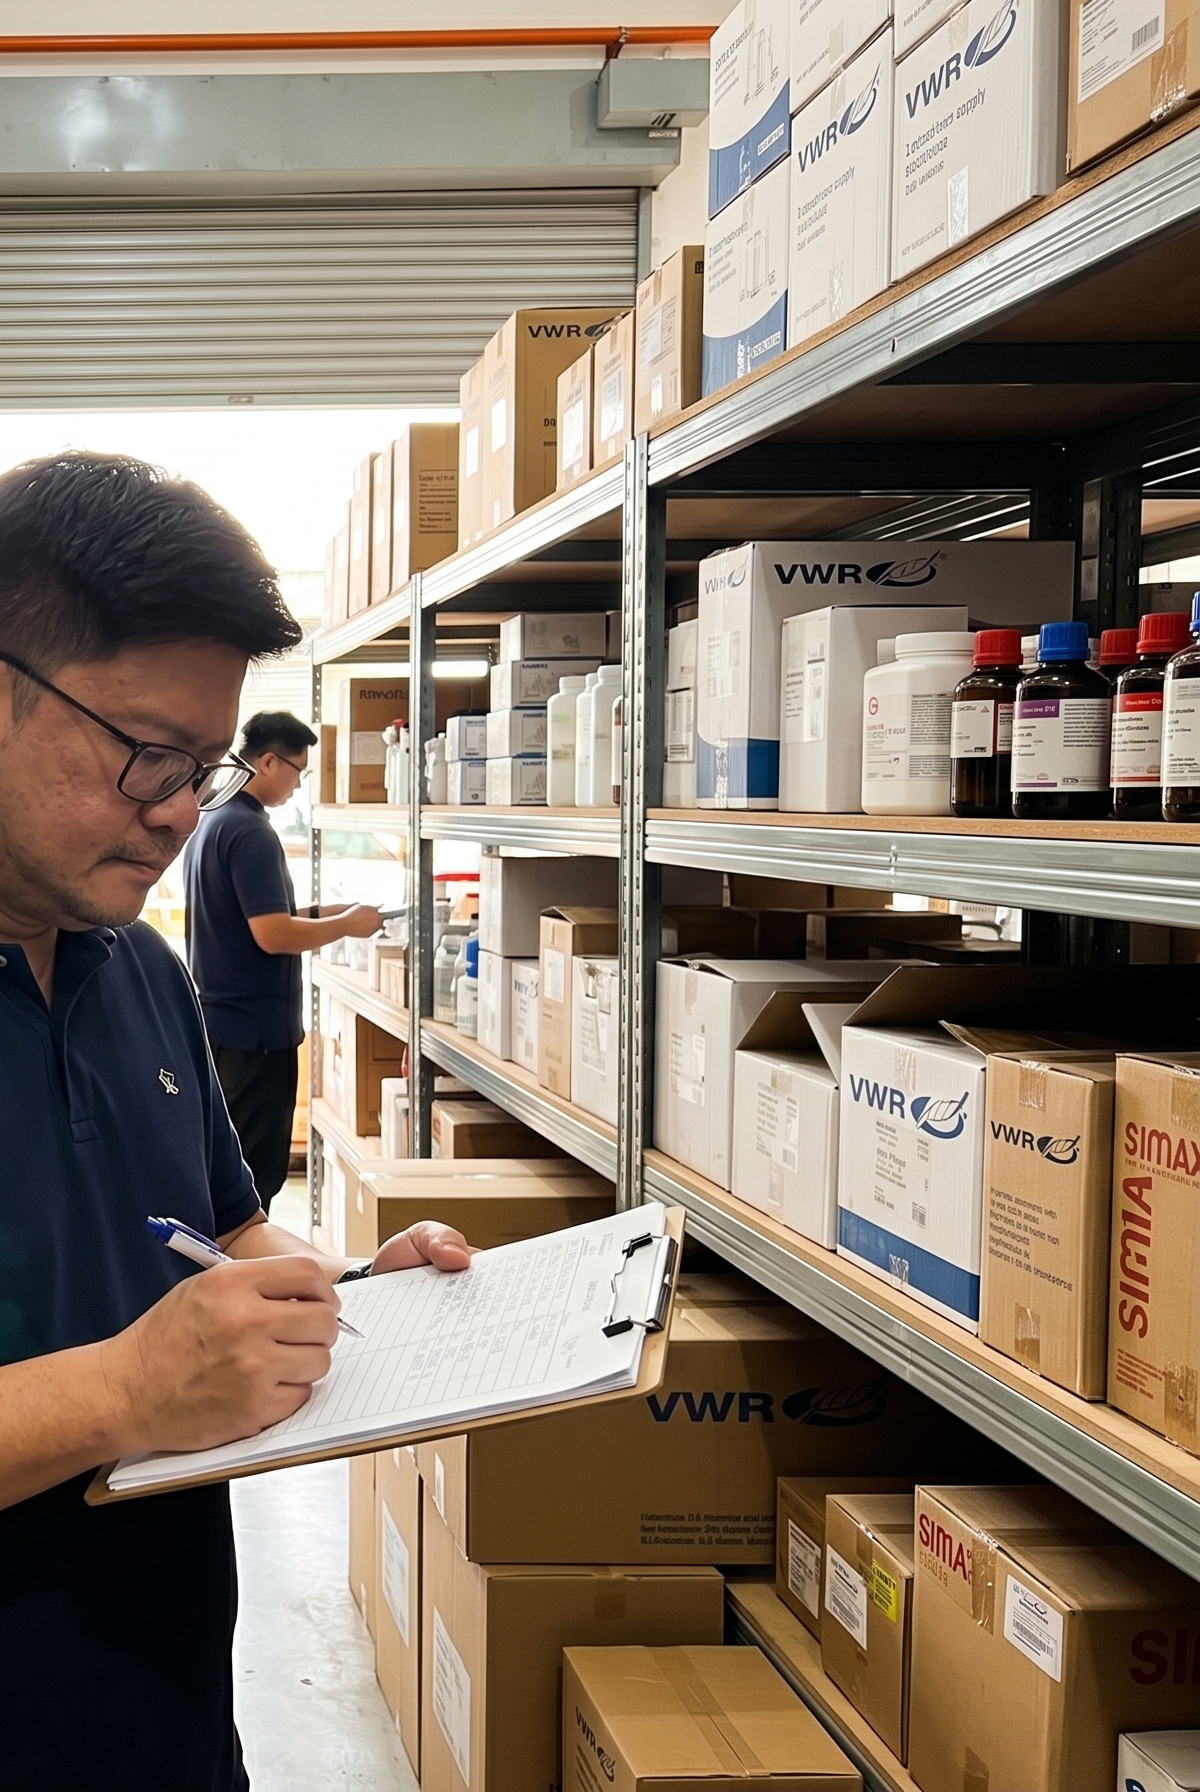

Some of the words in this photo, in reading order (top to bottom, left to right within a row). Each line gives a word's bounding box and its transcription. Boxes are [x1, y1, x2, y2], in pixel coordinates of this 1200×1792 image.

[905, 52, 962, 119] VWR
[797, 120, 838, 173] VWR
[528, 324, 582, 338] VWR
[774, 563, 862, 585] VWR
[849, 1073, 905, 1120] VWR
[990, 1120, 1035, 1151] VWR
[646, 1391, 775, 1423] VWR
